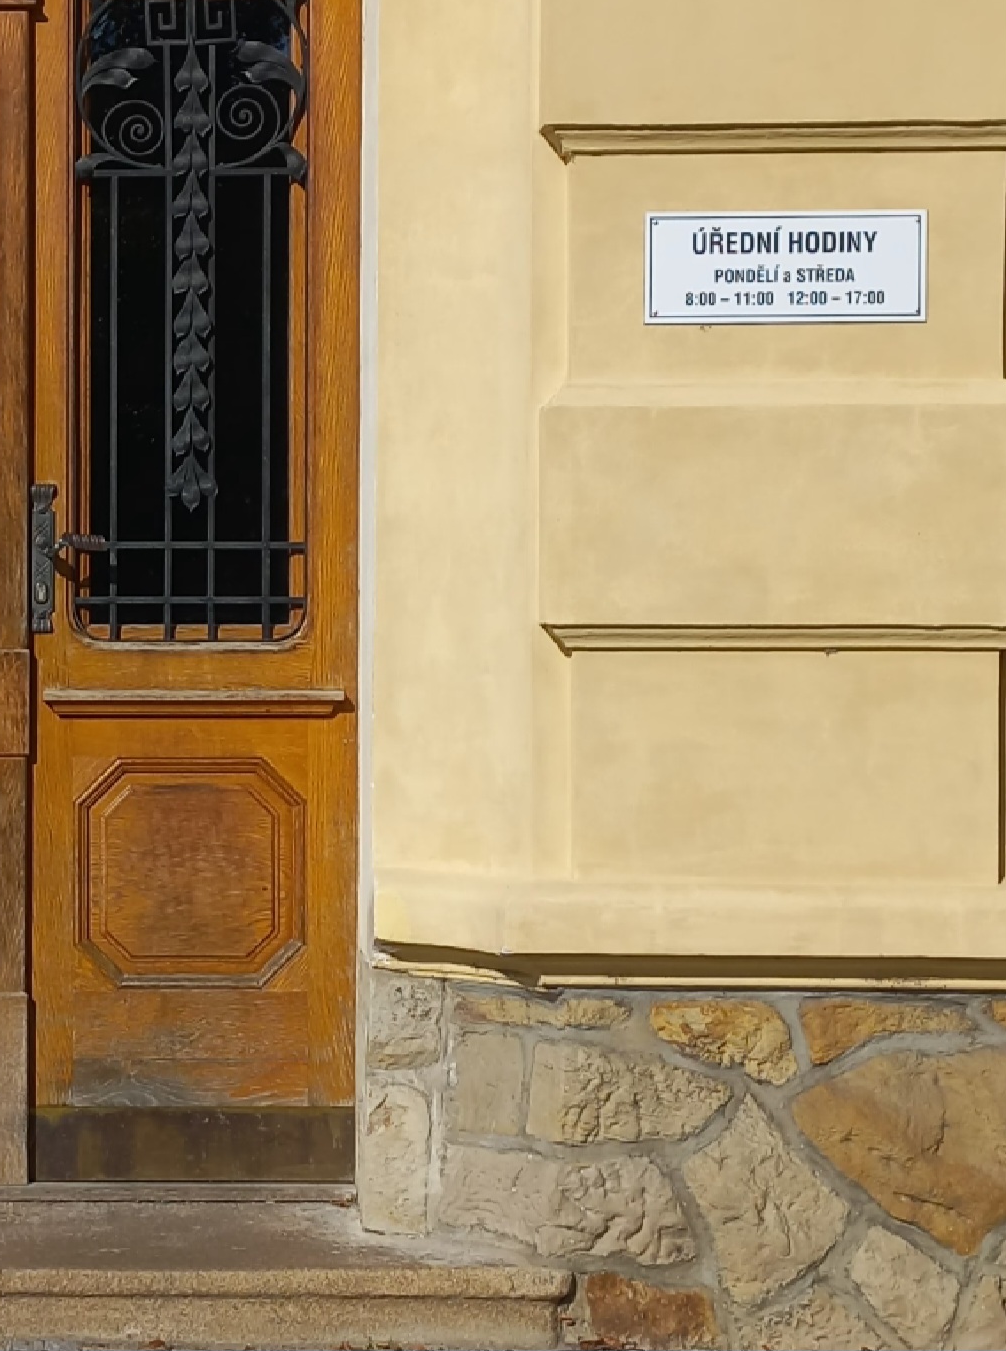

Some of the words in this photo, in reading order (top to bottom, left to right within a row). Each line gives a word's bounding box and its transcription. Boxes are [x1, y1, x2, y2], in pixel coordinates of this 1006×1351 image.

[692, 225, 782, 254] ÚŘEDNÍ
[789, 230, 878, 253] HODINY
[714, 264, 780, 283] PONDĚLÍ
[782, 270, 791, 283] a
[796, 263, 855, 283] STŘEDA
[685, 292, 716, 306] 8:00
[734, 291, 774, 306] 11:00
[788, 291, 827, 306] 12:00
[845, 290, 885, 305] 17:00
